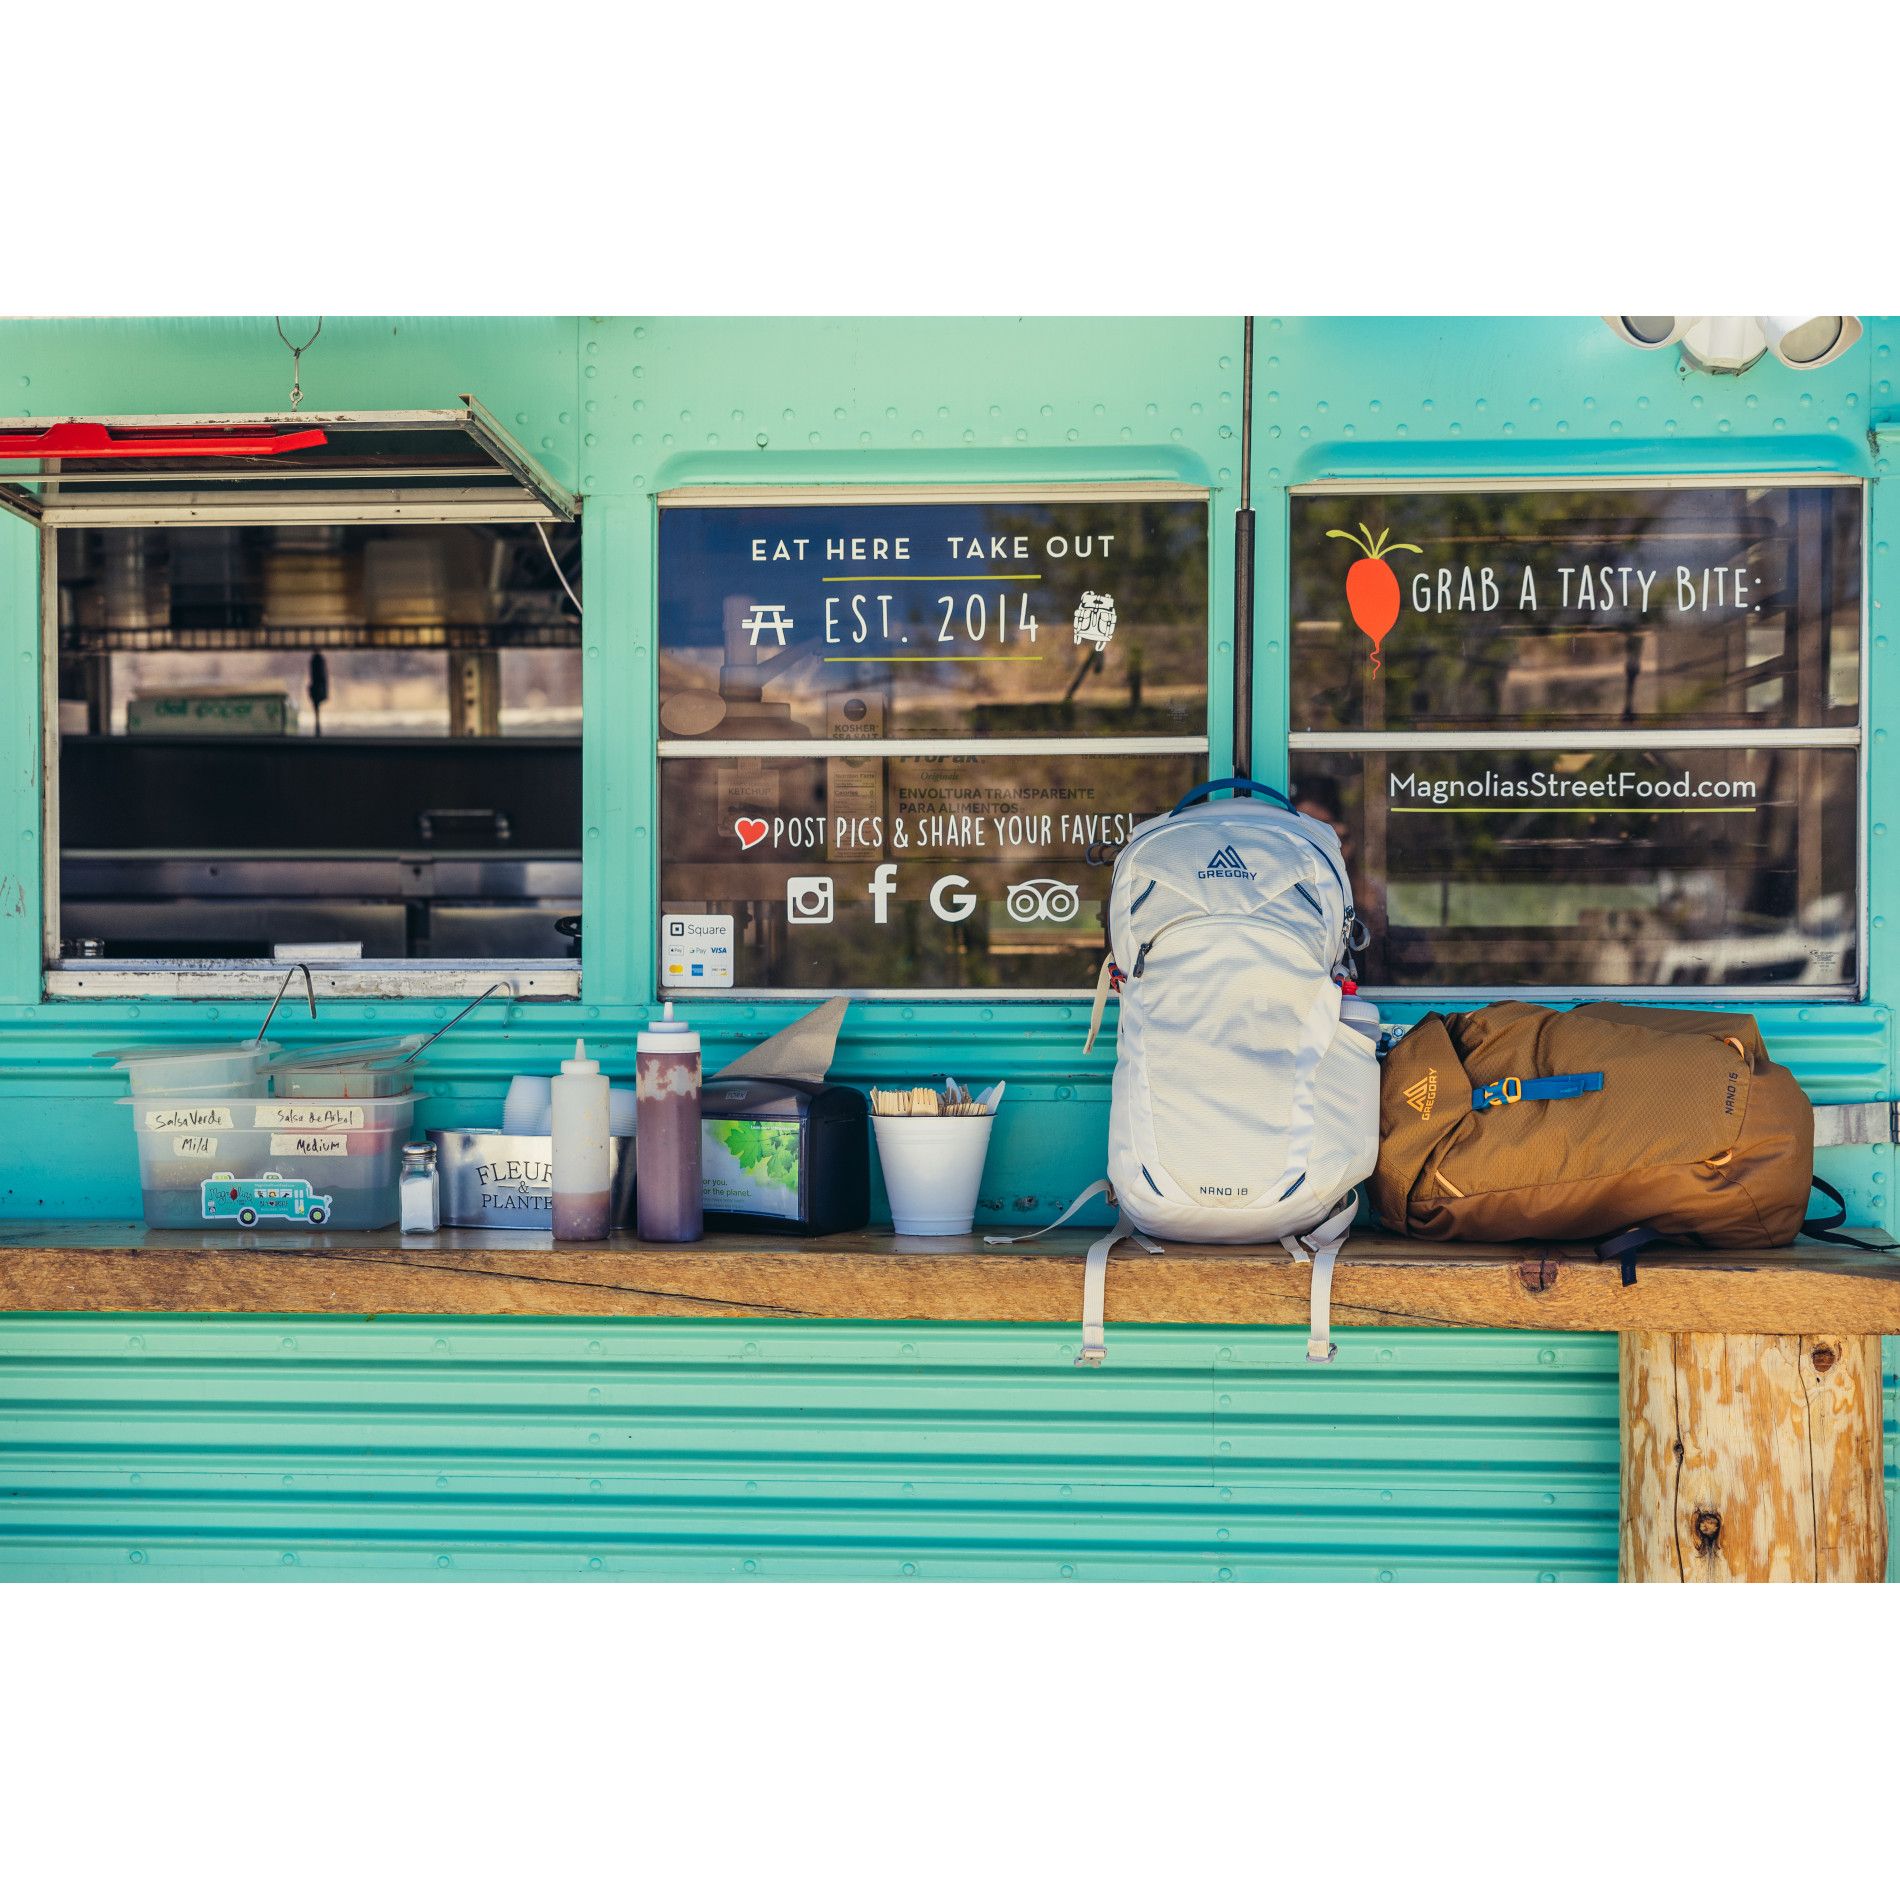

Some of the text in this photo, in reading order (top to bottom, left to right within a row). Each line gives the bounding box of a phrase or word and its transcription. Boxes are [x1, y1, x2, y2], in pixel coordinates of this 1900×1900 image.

[753, 535, 1115, 561] EAT HERE TAKE OUT
[1412, 564, 1762, 614] GRAB A TASTY BITE:
[825, 592, 1039, 644] EST. 2014
[834, 724, 876, 733] KOSHER
[728, 787, 771, 796] KETCHUP
[899, 788, 1095, 800] ENVOLTURA TRANSPARENTE
[1390, 770, 1756, 804] MagnoliasStreetFood.com
[899, 803, 1018, 814] PARA ALIMENTOS
[773, 812, 1133, 849] POST PICS & SHARE YOUR FAVES!
[1198, 869, 1257, 881] GREGORY
[687, 924, 727, 937] Square
[1421, 1067, 1437, 1121] GREGORY
[1725, 1085, 1736, 1115] NANO
[277, 1109, 305, 1123] Salsa
[181, 1137, 209, 1153] Mild
[296, 1138, 340, 1154] Medium
[518, 1180, 529, 1194] &
[712, 1188, 724, 1196] the
[1199, 1186, 1248, 1196] NANO 18
